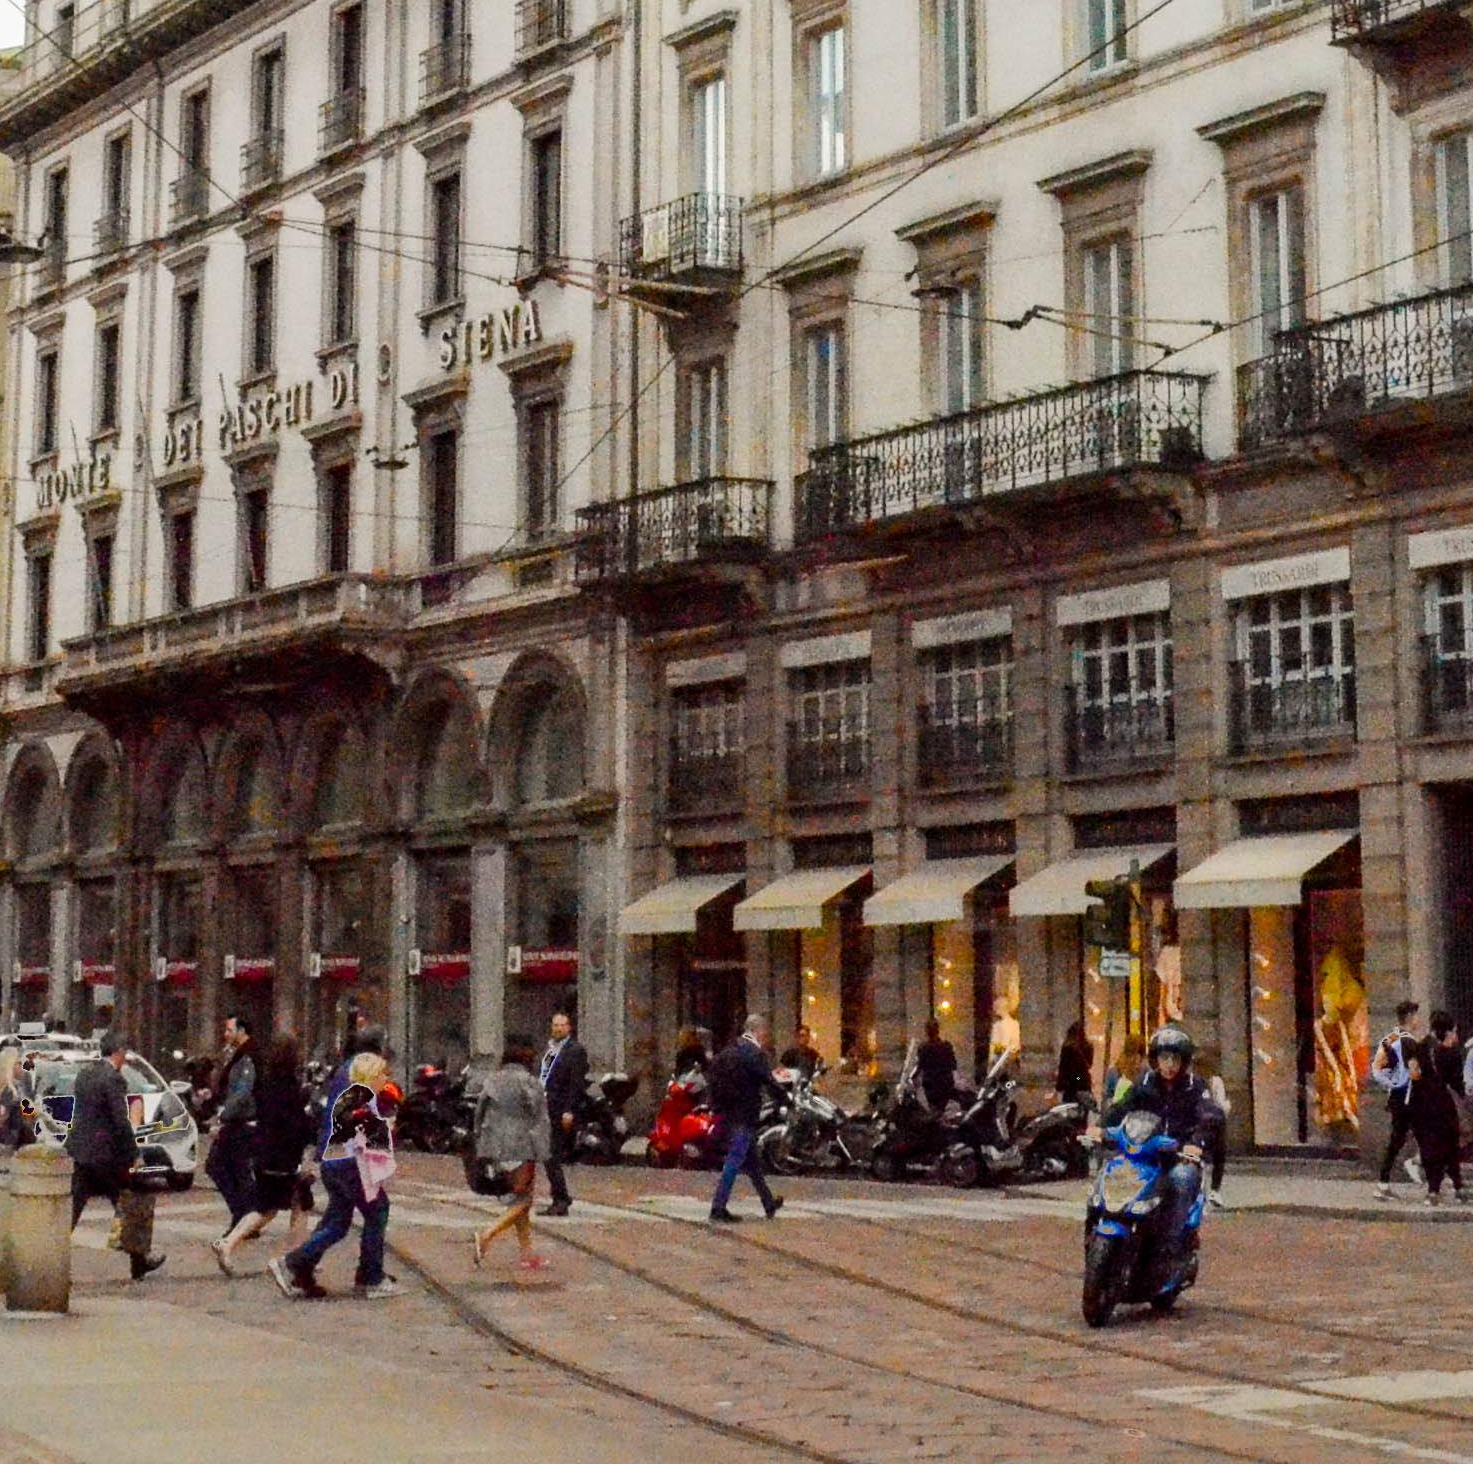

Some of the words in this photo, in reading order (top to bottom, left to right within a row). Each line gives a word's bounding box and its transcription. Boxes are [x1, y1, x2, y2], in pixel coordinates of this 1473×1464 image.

[37, 452, 112, 510] MONTE
[163, 414, 203, 466] DEI
[218, 380, 314, 450] PASCHI
[330, 362, 360, 410] DI
[439, 298, 543, 371] SIENA
